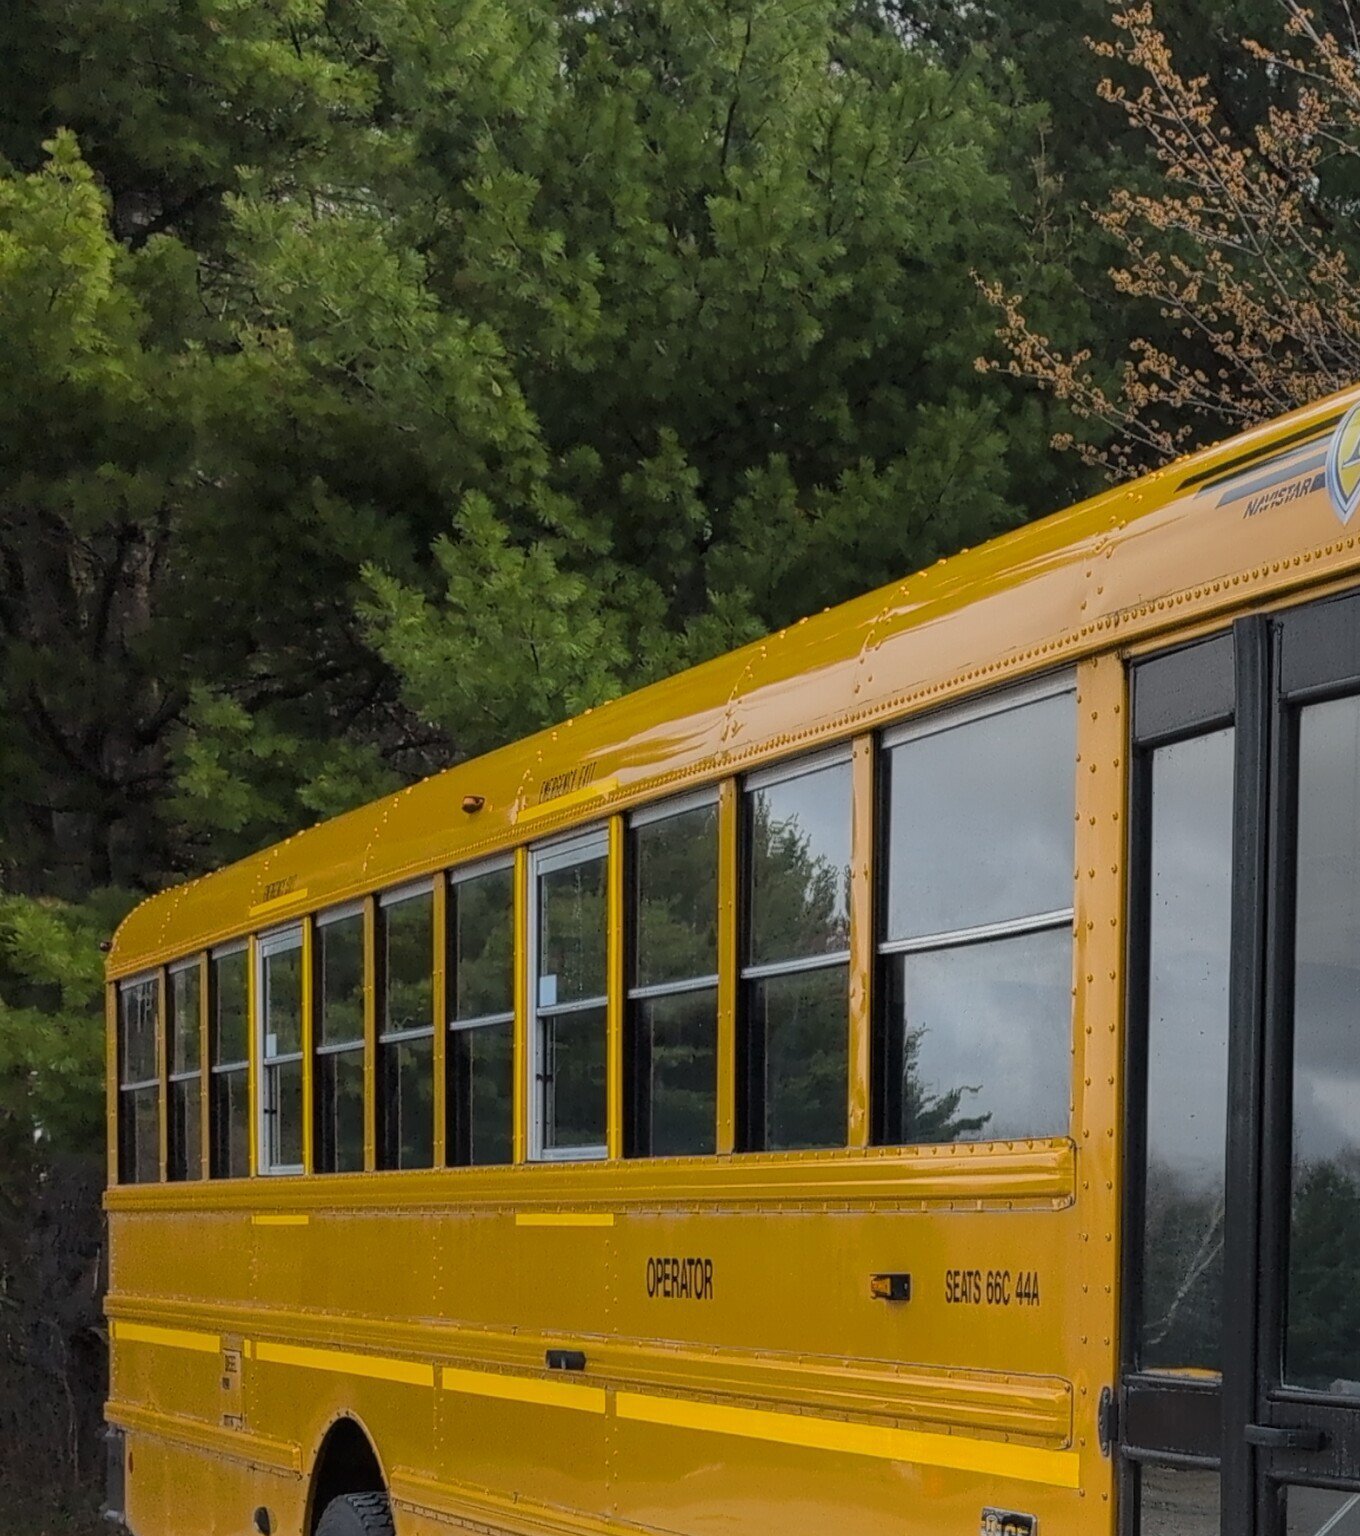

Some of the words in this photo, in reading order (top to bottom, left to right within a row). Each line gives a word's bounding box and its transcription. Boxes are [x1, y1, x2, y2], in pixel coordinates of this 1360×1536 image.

[1242, 477, 1312, 519] NAVISTAR
[646, 1257, 713, 1300] OPERATOR
[945, 1269, 982, 1304] SEATS
[986, 1269, 1011, 1306] 66C
[1015, 1270, 1040, 1307] 44A
